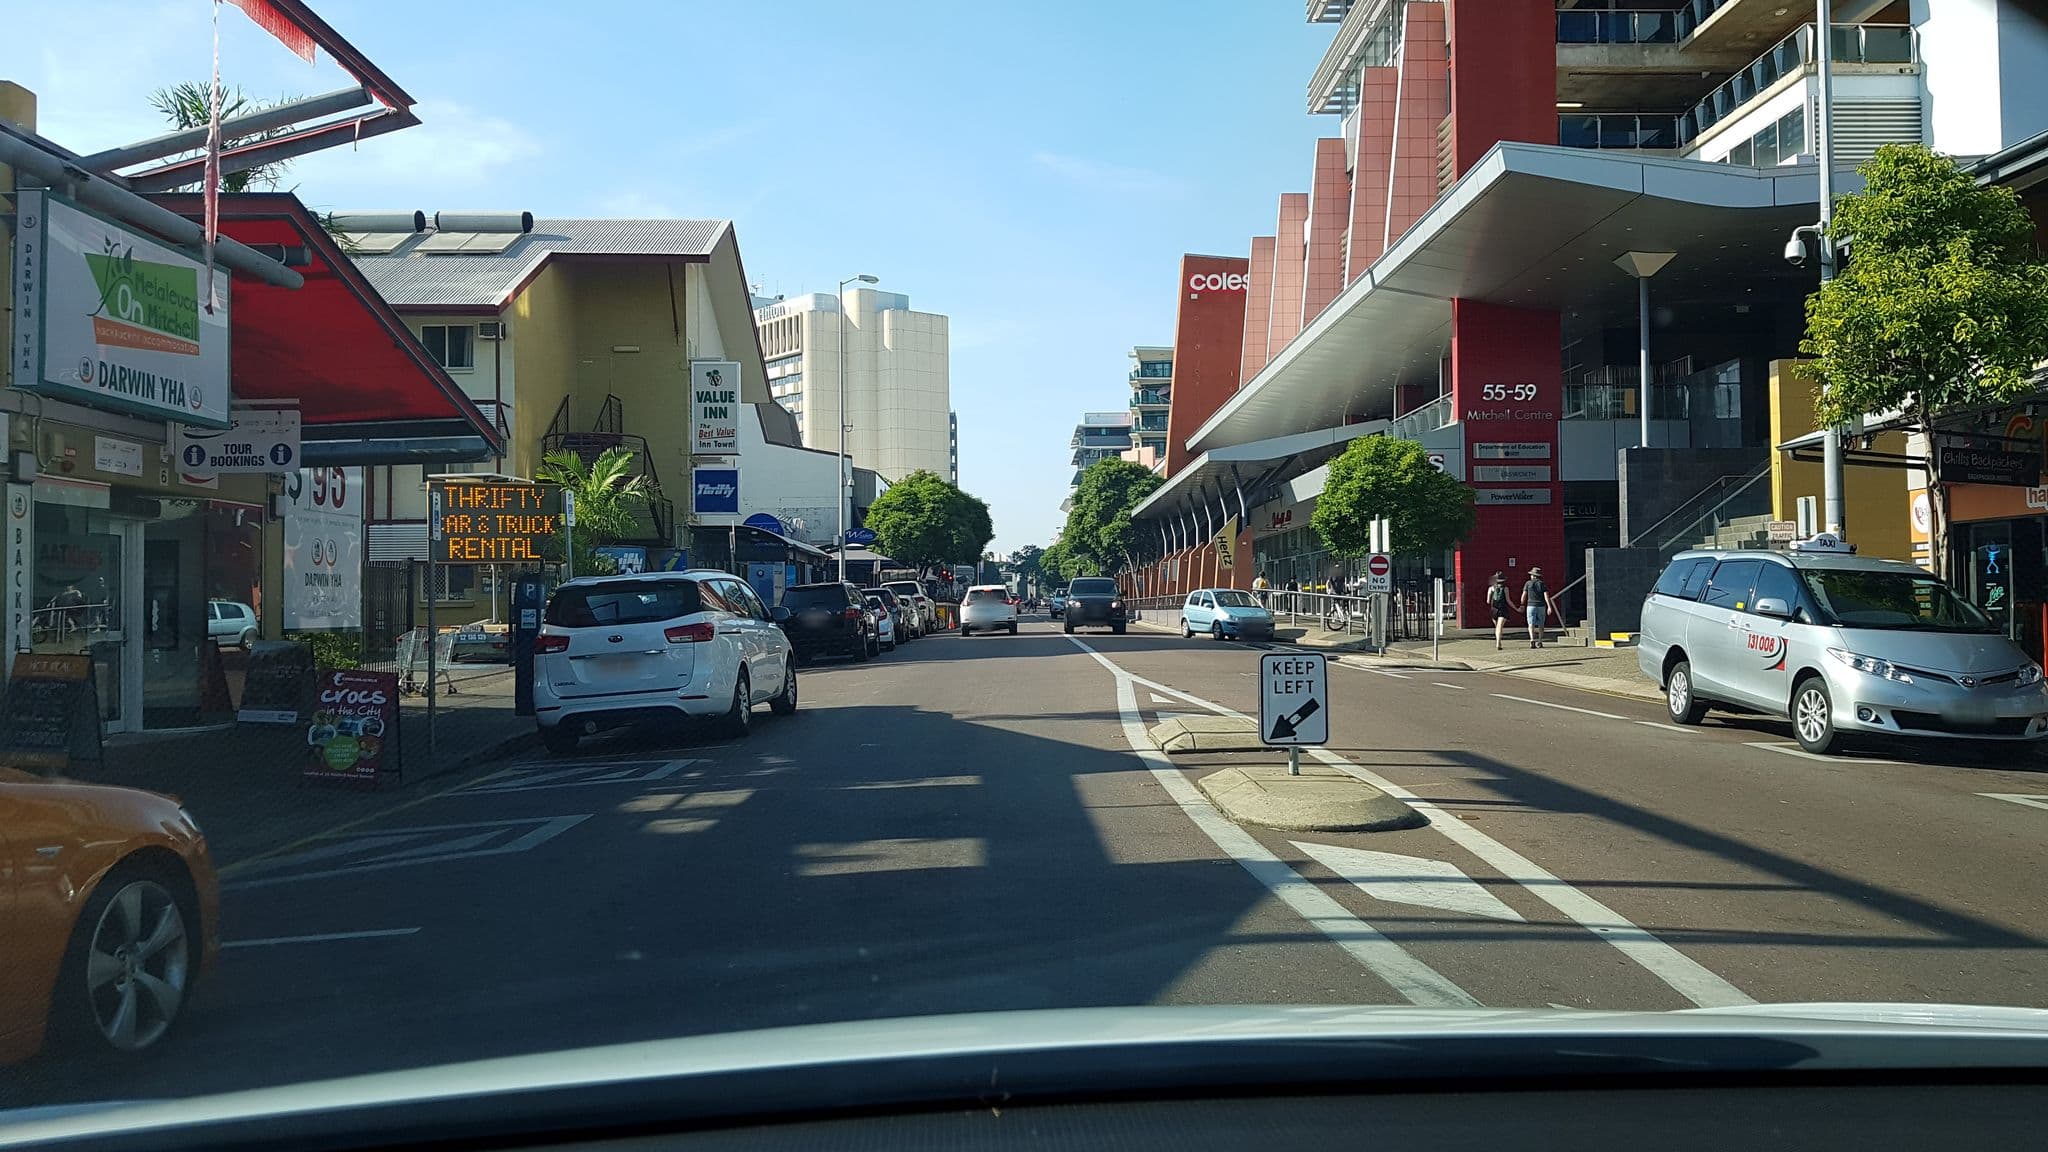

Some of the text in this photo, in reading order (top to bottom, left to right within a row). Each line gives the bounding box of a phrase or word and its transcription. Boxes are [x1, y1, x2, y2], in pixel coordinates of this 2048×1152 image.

[23, 243, 33, 370] DARWIN YHA
[117, 283, 144, 324] On
[99, 360, 186, 407] DARWIN YHA
[696, 390, 735, 403] VALUE
[1482, 384, 1537, 401] 55-59
[703, 406, 728, 419] INN
[1467, 408, 1553, 420] Mitchell Centre
[699, 427, 736, 438] Best Value
[223, 443, 252, 455] TOUR
[699, 440, 712, 448] Inn
[210, 455, 265, 467] BOOKINGS
[444, 486, 545, 509] THRIFTY
[697, 484, 736, 498] Thrifty
[478, 514, 490, 534] &
[496, 515, 556, 534] TRUCK
[1770, 523, 1795, 532] CAUTION
[449, 537, 542, 559] RENTAL
[1818, 538, 1836, 549] TAXI
[1217, 536, 1233, 566] Hertz
[304, 572, 342, 588] DARWIN YHA
[1272, 661, 1315, 675] KEEP
[1274, 680, 1314, 694] LEFT
[320, 688, 387, 705] crocs
[326, 705, 382, 721] in the City
